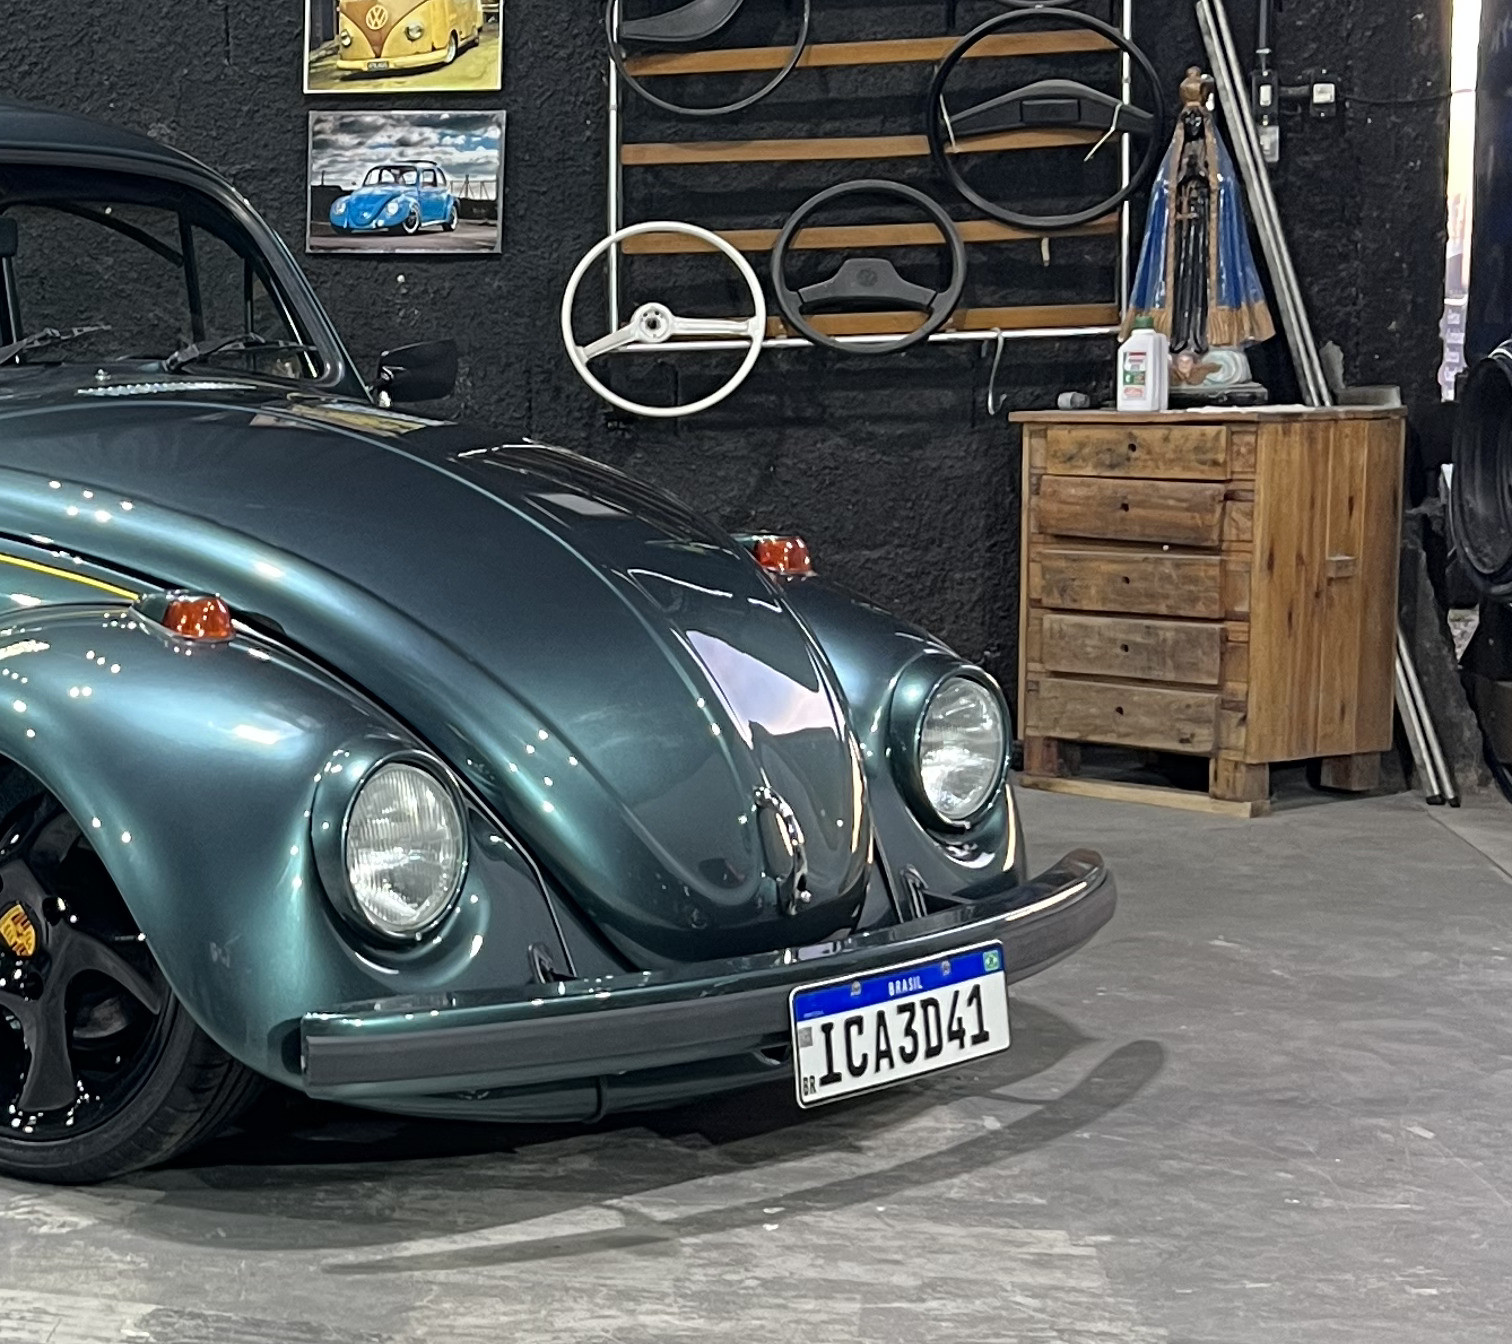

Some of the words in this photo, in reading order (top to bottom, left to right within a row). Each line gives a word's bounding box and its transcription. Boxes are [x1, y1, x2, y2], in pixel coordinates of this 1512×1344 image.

[888, 975, 923, 997] BRASIL
[819, 983, 990, 1087] ICA3D41
[802, 1075, 817, 1096] BR
